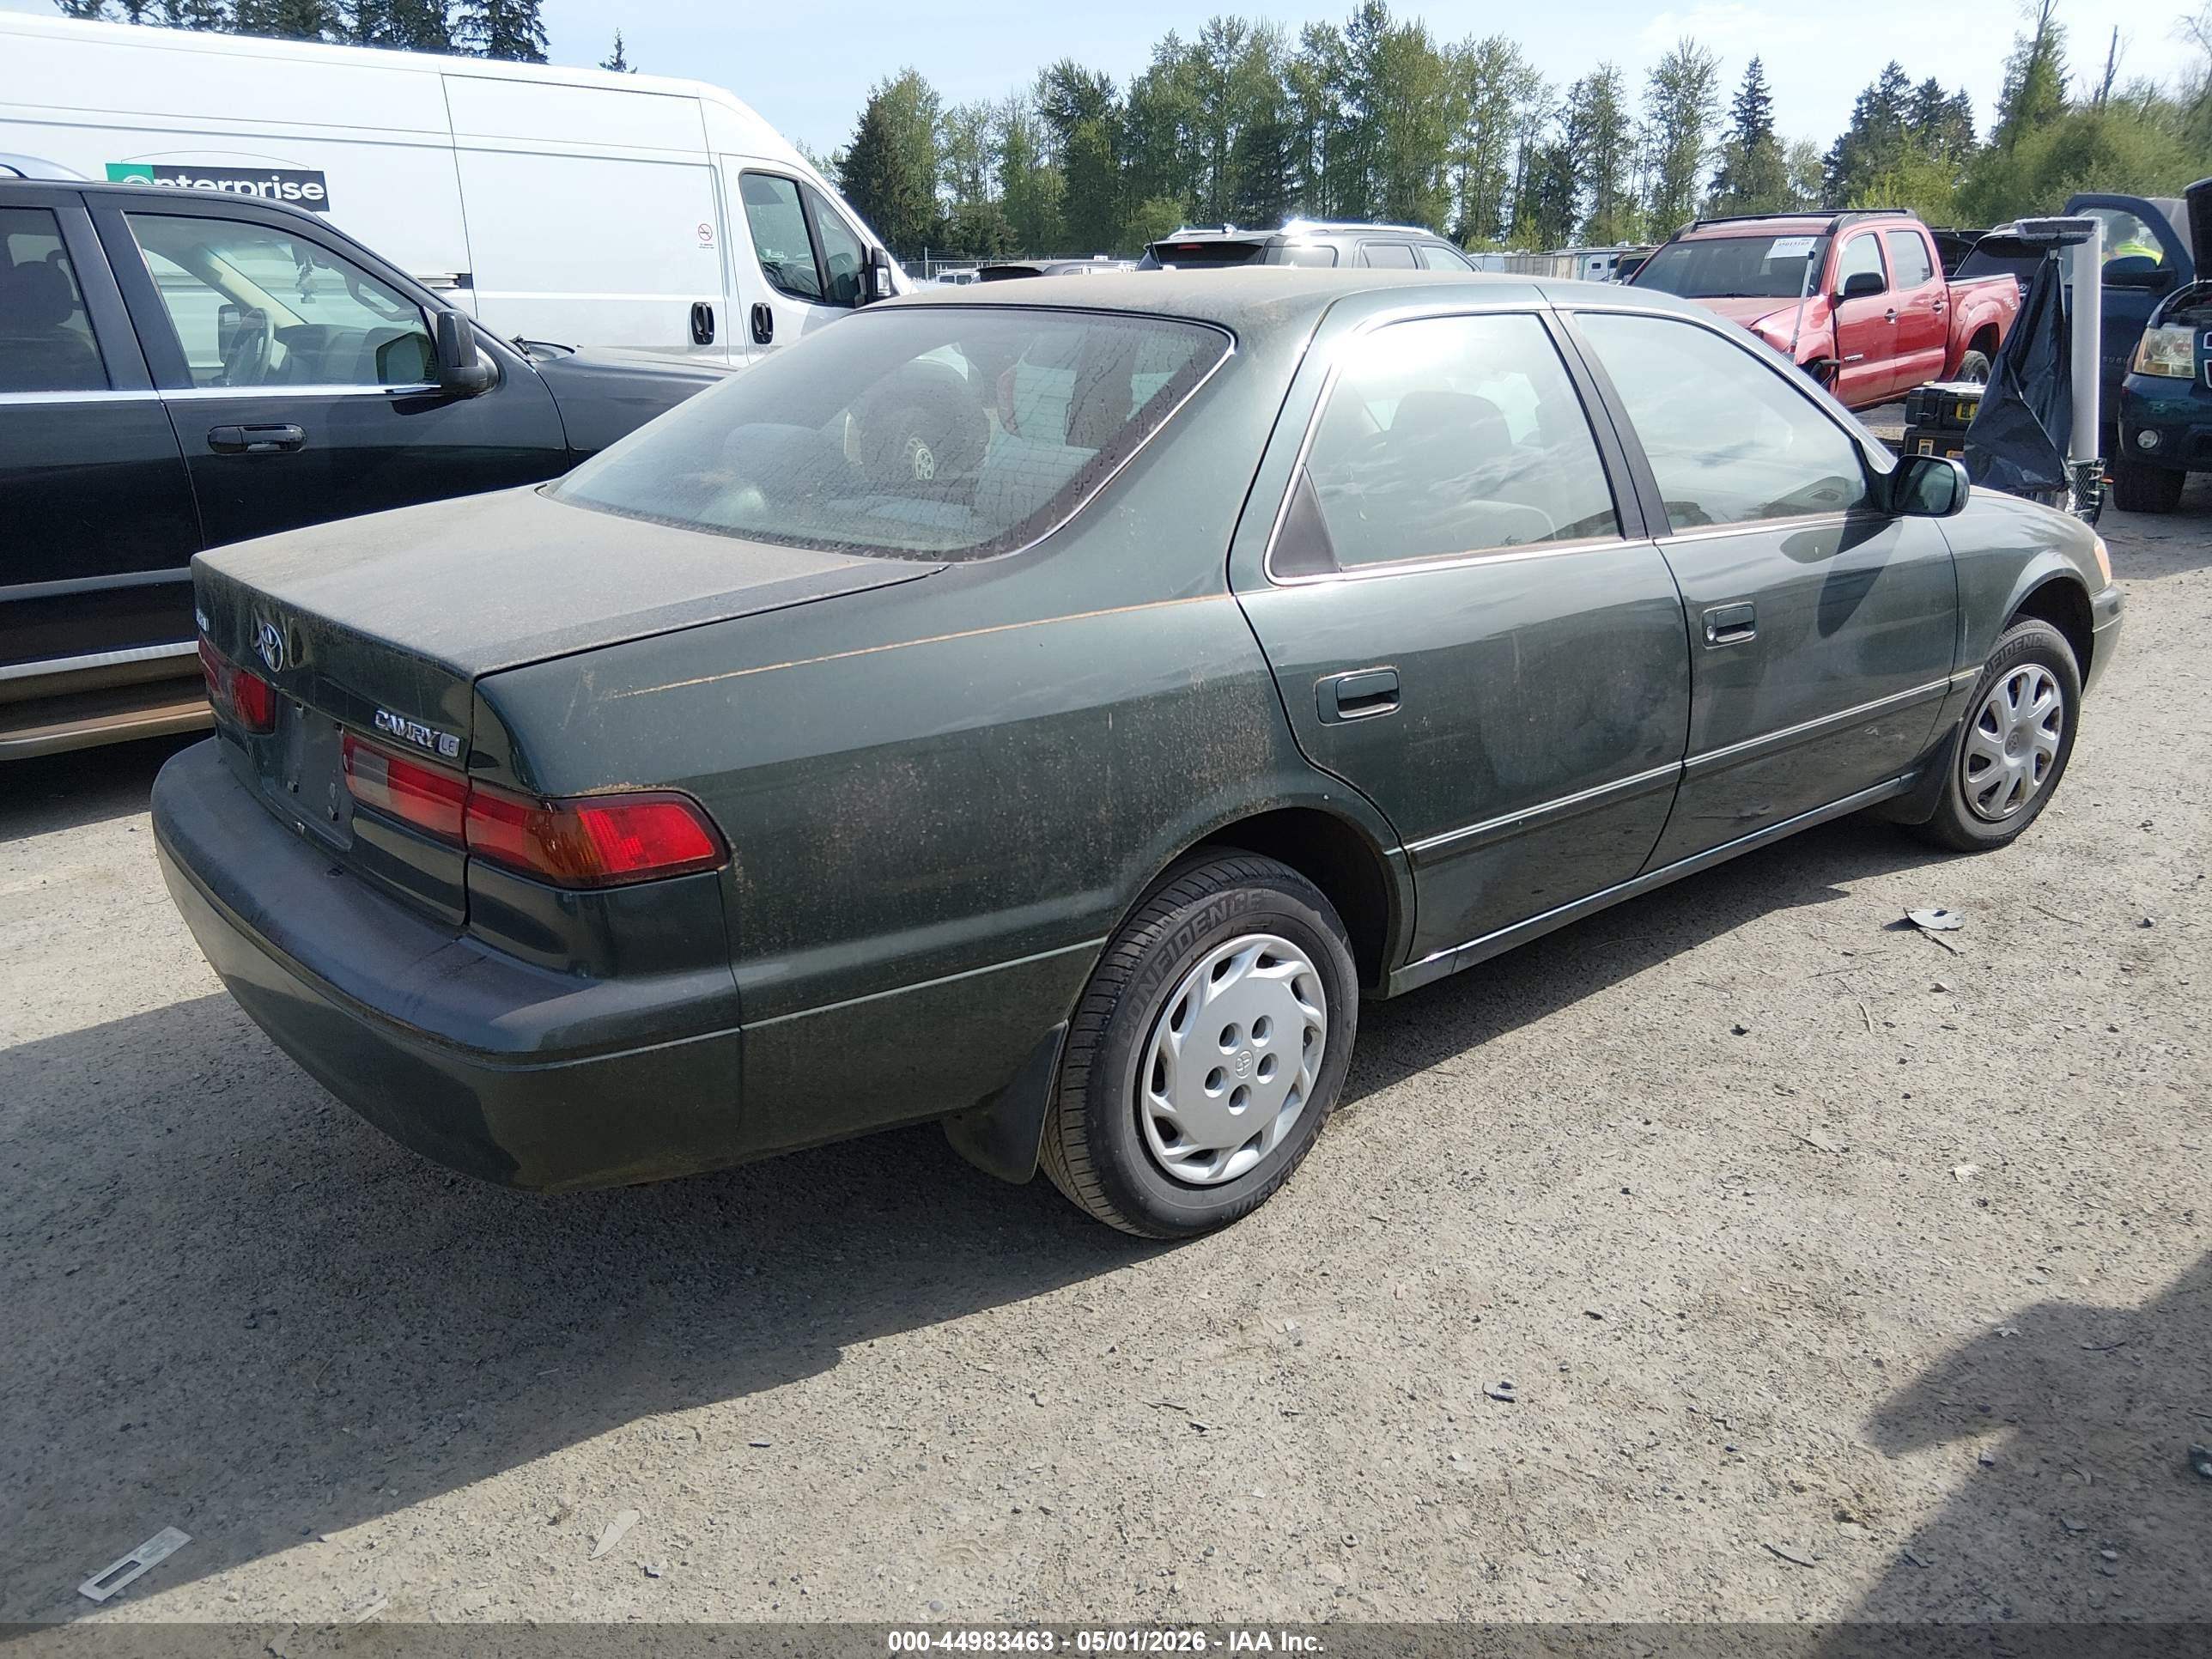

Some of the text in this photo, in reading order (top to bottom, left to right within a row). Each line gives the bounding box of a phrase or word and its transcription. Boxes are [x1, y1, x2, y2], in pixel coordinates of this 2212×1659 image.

[375, 710, 457, 755] CAMRY LE
[1118, 890, 1263, 1049] CONFIDENCE
